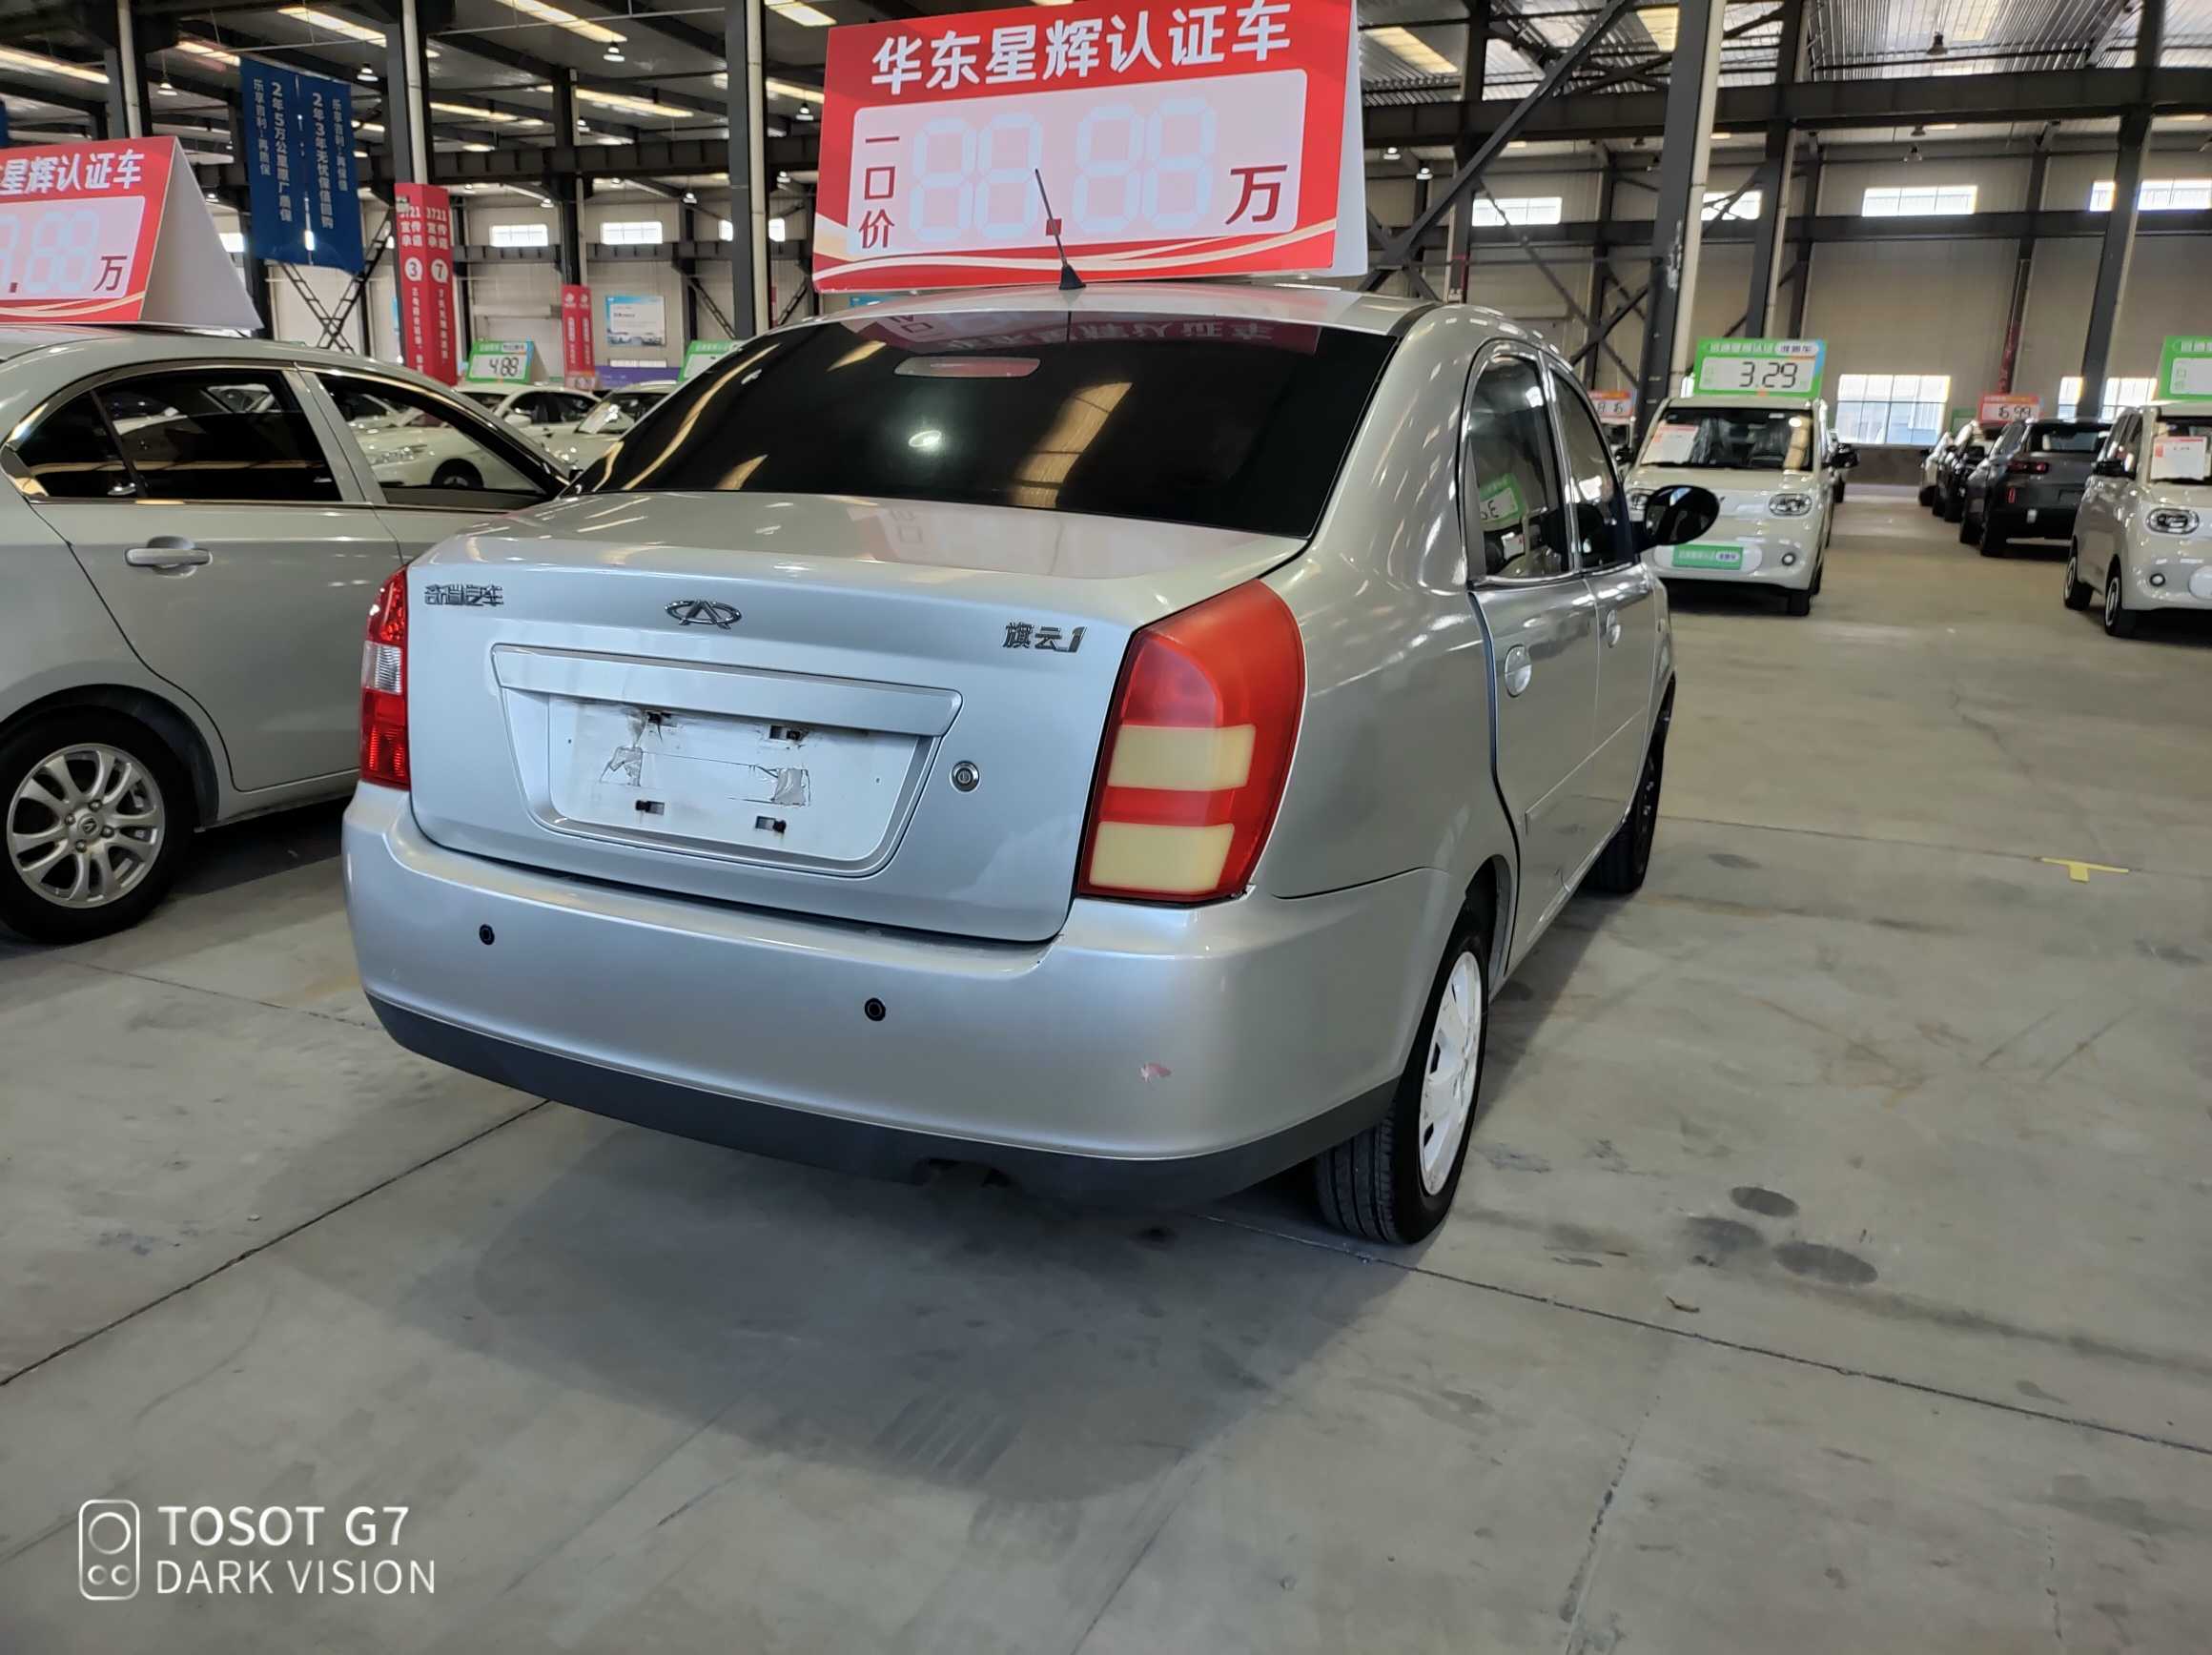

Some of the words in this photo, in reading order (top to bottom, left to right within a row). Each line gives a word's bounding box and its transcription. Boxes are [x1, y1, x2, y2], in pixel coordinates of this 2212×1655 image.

[870, 1, 1292, 95] 华东星辉认证车
[0, 149, 145, 196] 星辉认证车
[859, 136, 900, 249] 一口价
[1225, 164, 1289, 226] 万
[93, 255, 128, 292] 万
